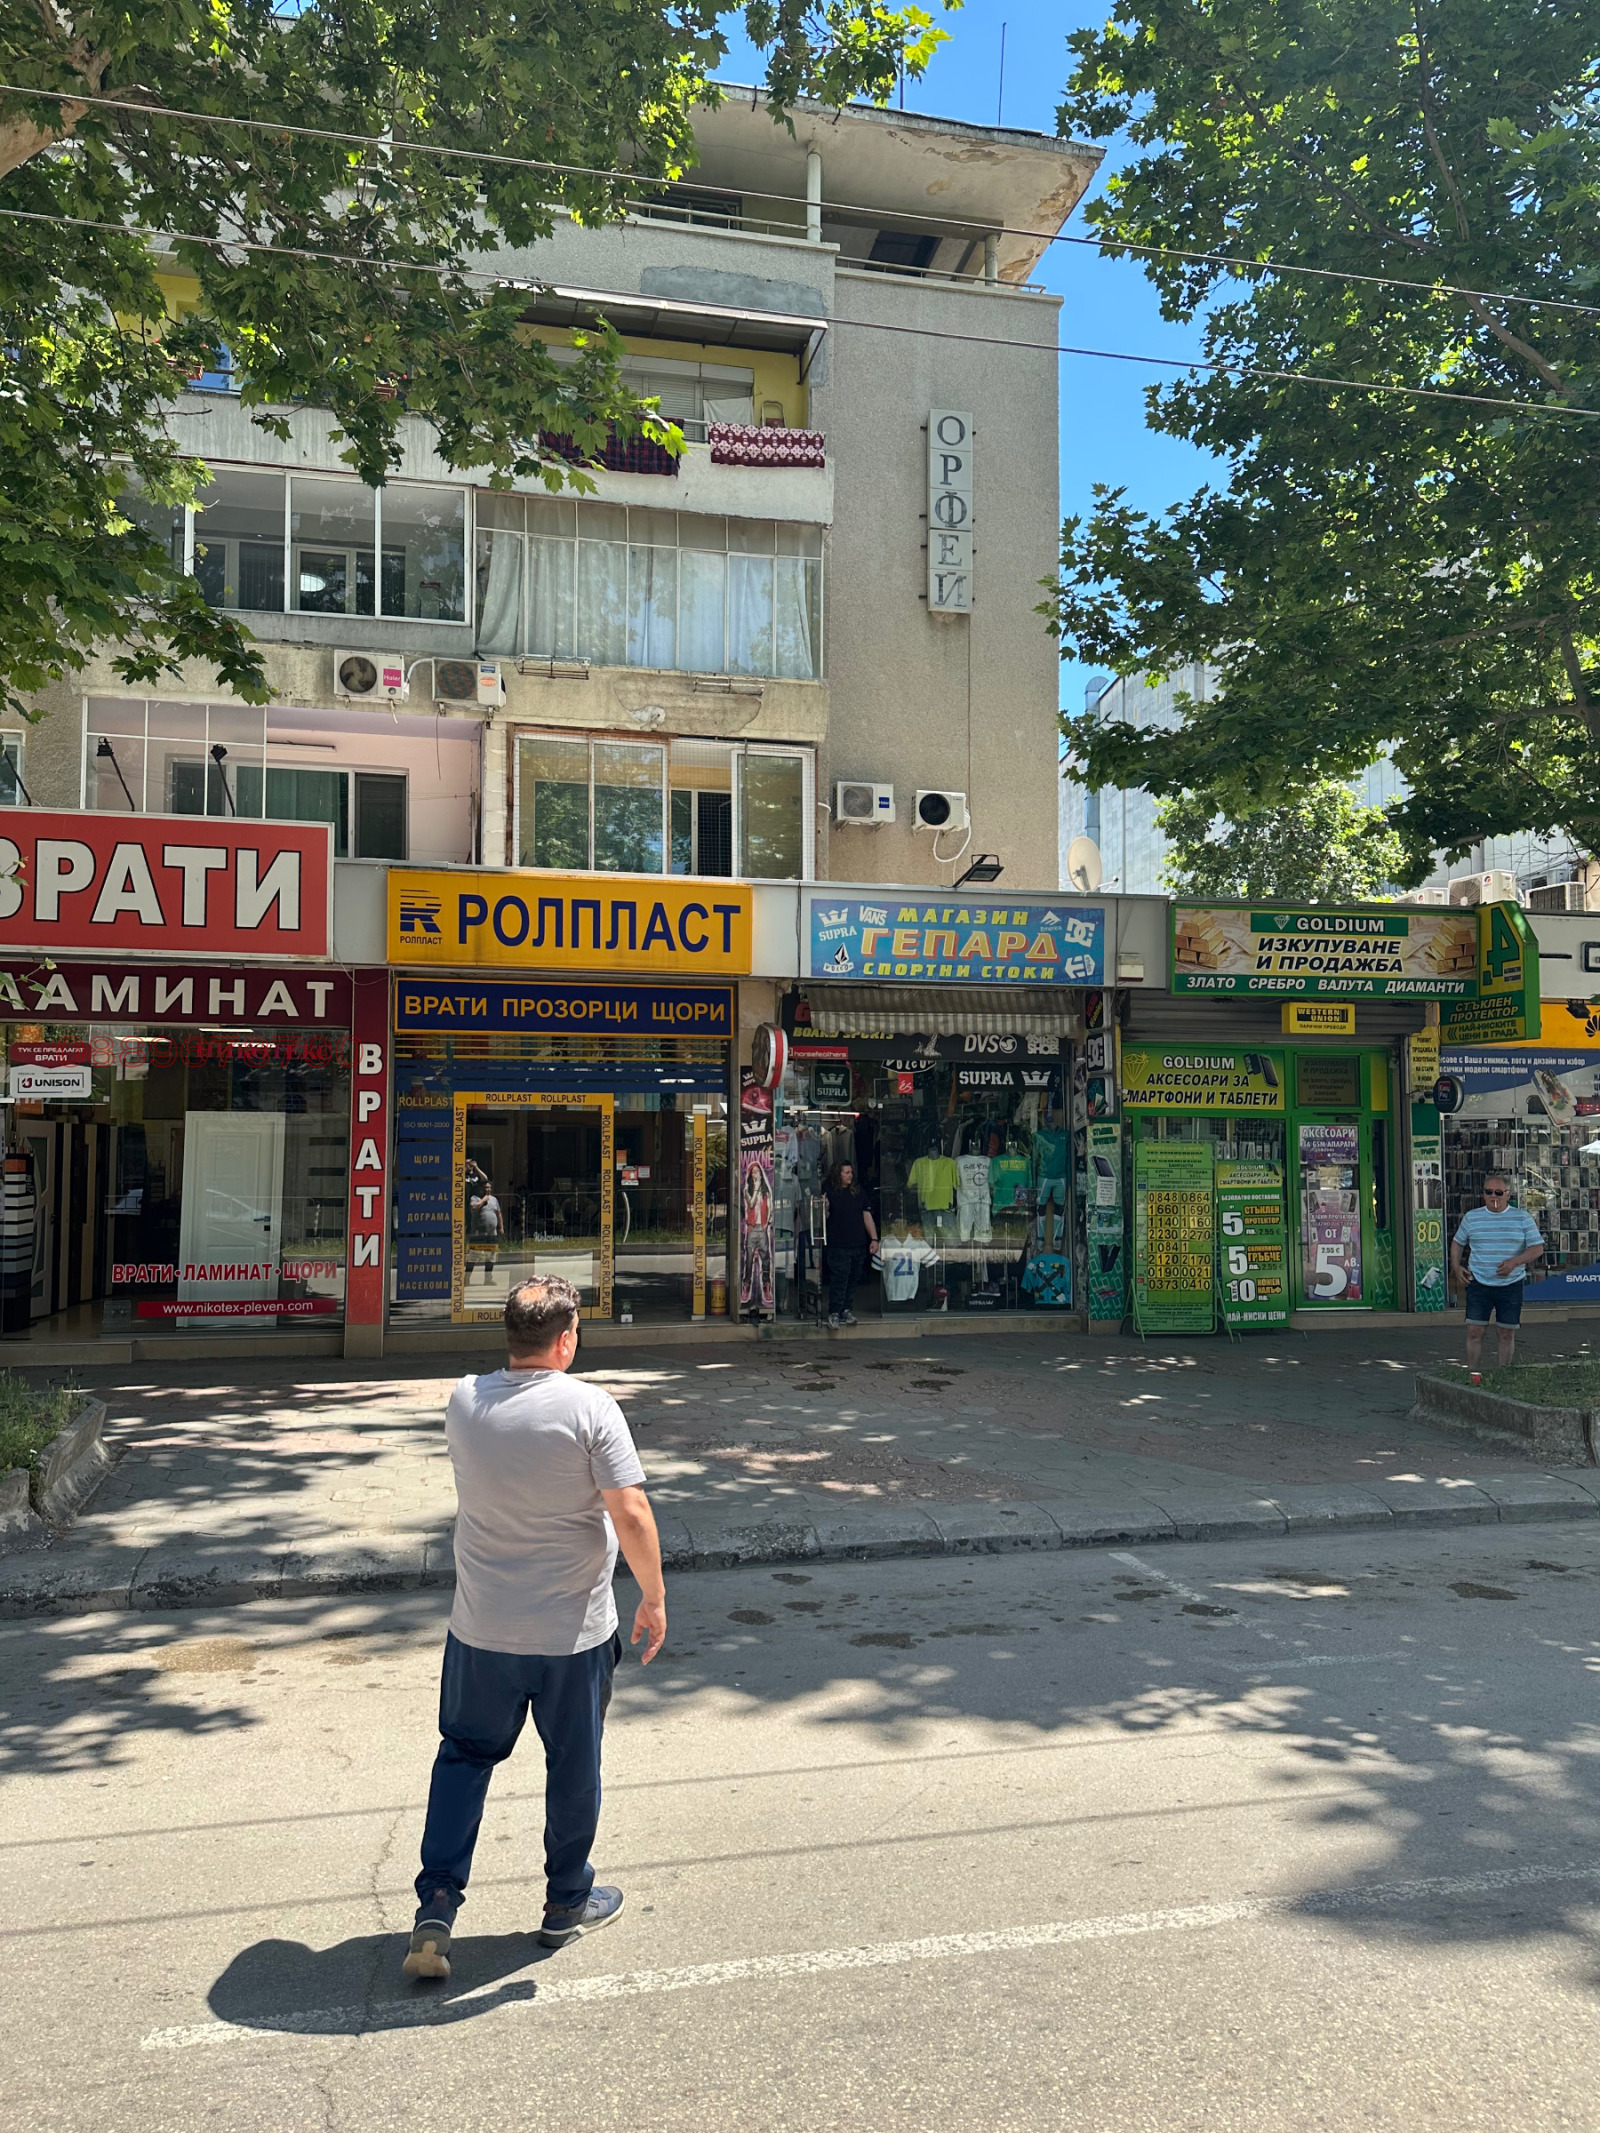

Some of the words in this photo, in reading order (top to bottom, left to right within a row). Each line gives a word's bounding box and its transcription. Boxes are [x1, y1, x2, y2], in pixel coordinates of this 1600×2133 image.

[458, 893, 741, 954] РОЛПЛАСТ
[859, 905, 889, 926] VANS
[897, 907, 1028, 926] МАГАЗИН
[1064, 917, 1096, 948] DC
[1296, 917, 1385, 933] GOLDIUM
[400, 935, 443, 946] РОЛПЛАСТ
[818, 926, 858, 942] SUPRA
[860, 927, 1060, 961] ГЕПАРД
[1258, 937, 1401, 955] ИЗКУПУВАНЕ
[863, 962, 971, 977] СПОРТНИ
[981, 963, 1054, 980] СТОКИ
[1255, 956, 1271, 970] И
[1278, 956, 1403, 973] ПРОДАЖБА
[1187, 977, 1236, 989] ЗЛАТО
[1248, 977, 1306, 990] СРЕБРО
[1317, 979, 1374, 991] ВАЛУТА
[1385, 980, 1465, 994] ДИАМАНТИ
[405, 996, 487, 1016] ВРАТИ
[503, 998, 637, 1022] ПРОЗОРЦИ
[652, 1001, 725, 1023] ЩОРИ
[1298, 1008, 1340, 1016] WESTERN
[1455, 997, 1512, 1012] СТЪКЛЕН
[1449, 1006, 1519, 1022] ПРОТЕКТОР
[1458, 1020, 1516, 1032] НАЙ-НИСКИТЕ
[1459, 1031, 1480, 1041] ЦЕНИ
[1490, 1028, 1518, 1038] ГРАДА
[964, 1034, 1000, 1053] DVS
[1162, 1056, 1235, 1070] GOLDIUM
[1464, 1055, 1482, 1064] Ваша
[1484, 1057, 1510, 1065] снимка,
[1533, 1056, 1556, 1066] дизайн
[1566, 1056, 1585, 1066] избор
[959, 1071, 1014, 1085] SUPRA
[1464, 1066, 1490, 1074] модели
[1491, 1066, 1528, 1075] смартфони
[35, 1079, 80, 1087] UNISON
[1146, 1073, 1229, 1087] АКСЕСОАРИ
[1233, 1075, 1249, 1087] ЗА
[486, 1093, 532, 1102] ROLLPLAST
[541, 1094, 586, 1103] ROLLPLAST
[816, 1087, 848, 1097] SUPRA
[1122, 1089, 1202, 1104] СМАРТФОНИ
[1206, 1091, 1215, 1104] И
[1219, 1092, 1278, 1106] ТАБЛЕТИ
[399, 1096, 454, 1107] ROLLPLAST
[455, 1106, 464, 1153] ROLLPLAST
[602, 1114, 610, 1160] ROLLPLAST
[1303, 1128, 1355, 1138] АКСЕСОАРИ
[741, 1133, 773, 1146] SUPRA
[353, 1042, 384, 1268] ВРАТИ
[414, 1155, 440, 1164] ЩОРИ
[695, 1137, 703, 1182] ROLLPLAST
[455, 1161, 464, 1209] ROLLPLAST
[409, 1192, 426, 1201] PVC
[438, 1192, 448, 1200] AL
[407, 1212, 449, 1222] ДОГРАМА
[695, 1191, 703, 1236] ROLLPLAST
[1244, 1205, 1280, 1214] СТЪКЛЕН
[1222, 1211, 1243, 1236] 5
[534, 1231, 564, 1242] Welcome
[1325, 1229, 1338, 1238] ОТ
[1417, 1221, 1440, 1243] 8D
[454, 1219, 463, 1266] ROLLPLAST
[602, 1223, 610, 1270] ROLLPLAST
[409, 1247, 442, 1256] МРЕЖИ
[1247, 1252, 1281, 1261] ГРЪБЧЕ
[407, 1264, 442, 1273] ПРОТИВ
[695, 1245, 703, 1291] ROLLPLAST
[892, 1251, 914, 1277] 21
[1228, 1246, 1248, 1275] 5
[112, 1264, 173, 1283] ВРАТИ
[182, 1263, 273, 1281] ЛАМИНАТ
[282, 1261, 337, 1283] ЩОРИ
[1313, 1244, 1348, 1297] 5
[1566, 1274, 1600, 1283] SMART
[399, 1281, 448, 1290] НАСЕКОМИ
[453, 1266, 463, 1313] ROLLPLAST
[602, 1270, 610, 1316] ROLLPLAST
[1226, 1279, 1255, 1302] 10
[163, 1301, 313, 1315] www.nikotex-pleven.com
[478, 1311, 505, 1321] ROLLP
[1227, 1311, 1267, 1321] НАЙ-НИСКИ
[1268, 1311, 1286, 1321] ЦЕНИ
